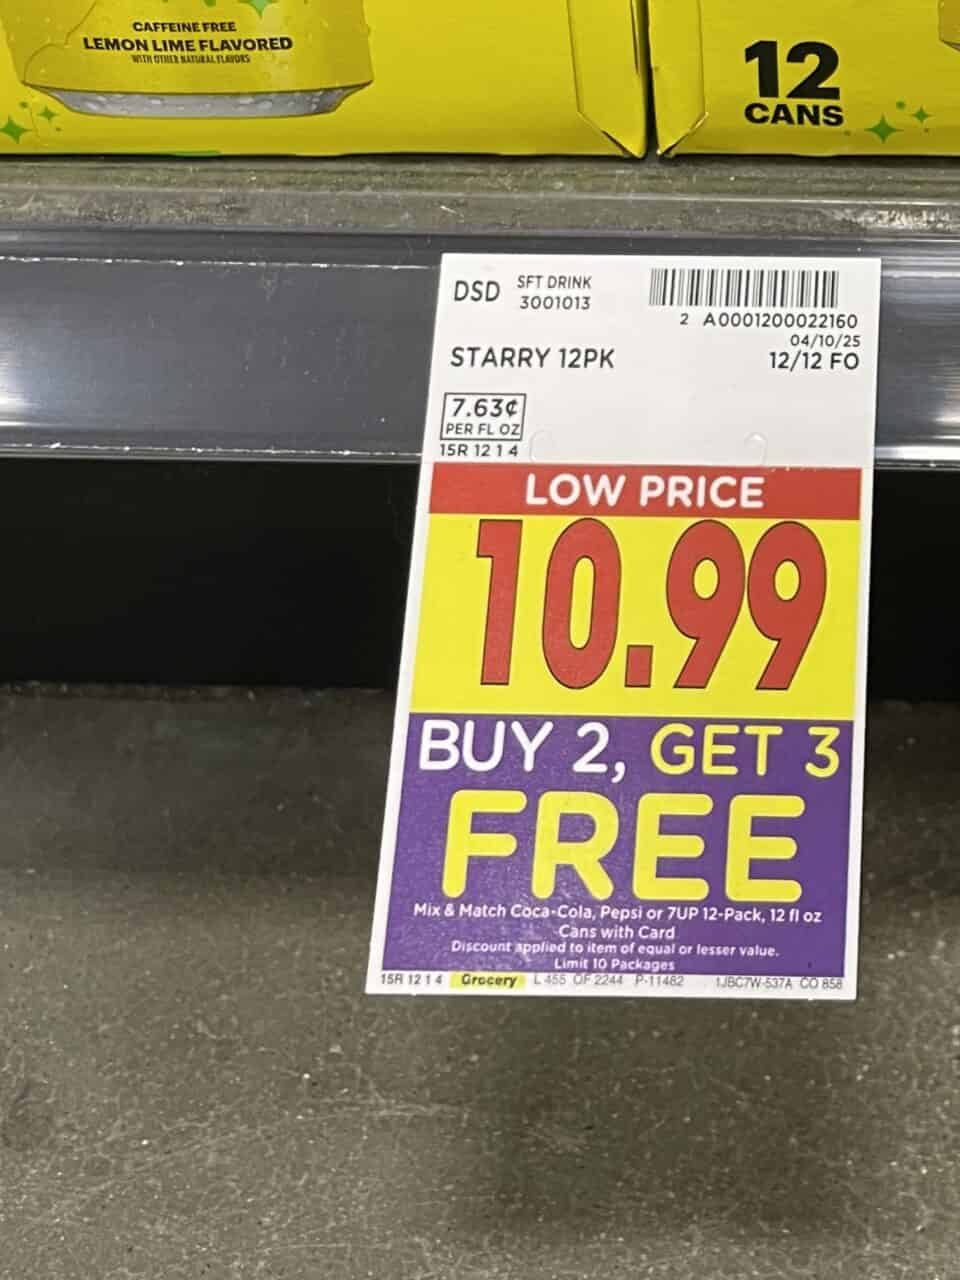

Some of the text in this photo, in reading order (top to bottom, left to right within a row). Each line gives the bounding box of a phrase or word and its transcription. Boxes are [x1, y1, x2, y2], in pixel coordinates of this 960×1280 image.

[132, 21, 237, 33] CAFFEINE FREE
[83, 36, 293, 52] LEMON LIME FLAVORED
[744, 40, 841, 100] 12
[744, 102, 845, 127] CANS
[517, 275, 592, 289] SFT DRINK
[454, 280, 500, 302] DSD
[519, 295, 591, 310] 3001013
[680, 312, 858, 329] 2 A0001200022160
[790, 334, 860, 348] 04/10/25
[450, 346, 615, 369] STARRY 12PK
[769, 349, 860, 372] 12/12 FO
[452, 397, 519, 418] 7.63¢
[445, 422, 521, 436] PER FL OZ
[440, 443, 519, 457] 15R 12 1 4
[525, 473, 766, 509] LOW PRICE
[476, 517, 828, 690] 10.99
[418, 720, 841, 784] BUY 2, GET 3
[441, 789, 805, 902] FREE
[414, 903, 823, 924] Mix & Match Coca-Cola, Pepsi or 7UP 12-Pack, 12 fl oz
[558, 924, 676, 940] Cans with Card
[451, 940, 780, 958] Discount applied to item of equal or lesser value.
[554, 958, 676, 973] Limit 10 Packages
[408, 974, 421, 985] 12
[434, 974, 443, 985] 4
[460, 973, 518, 987] Grocery
[799, 978, 818, 990] CO
